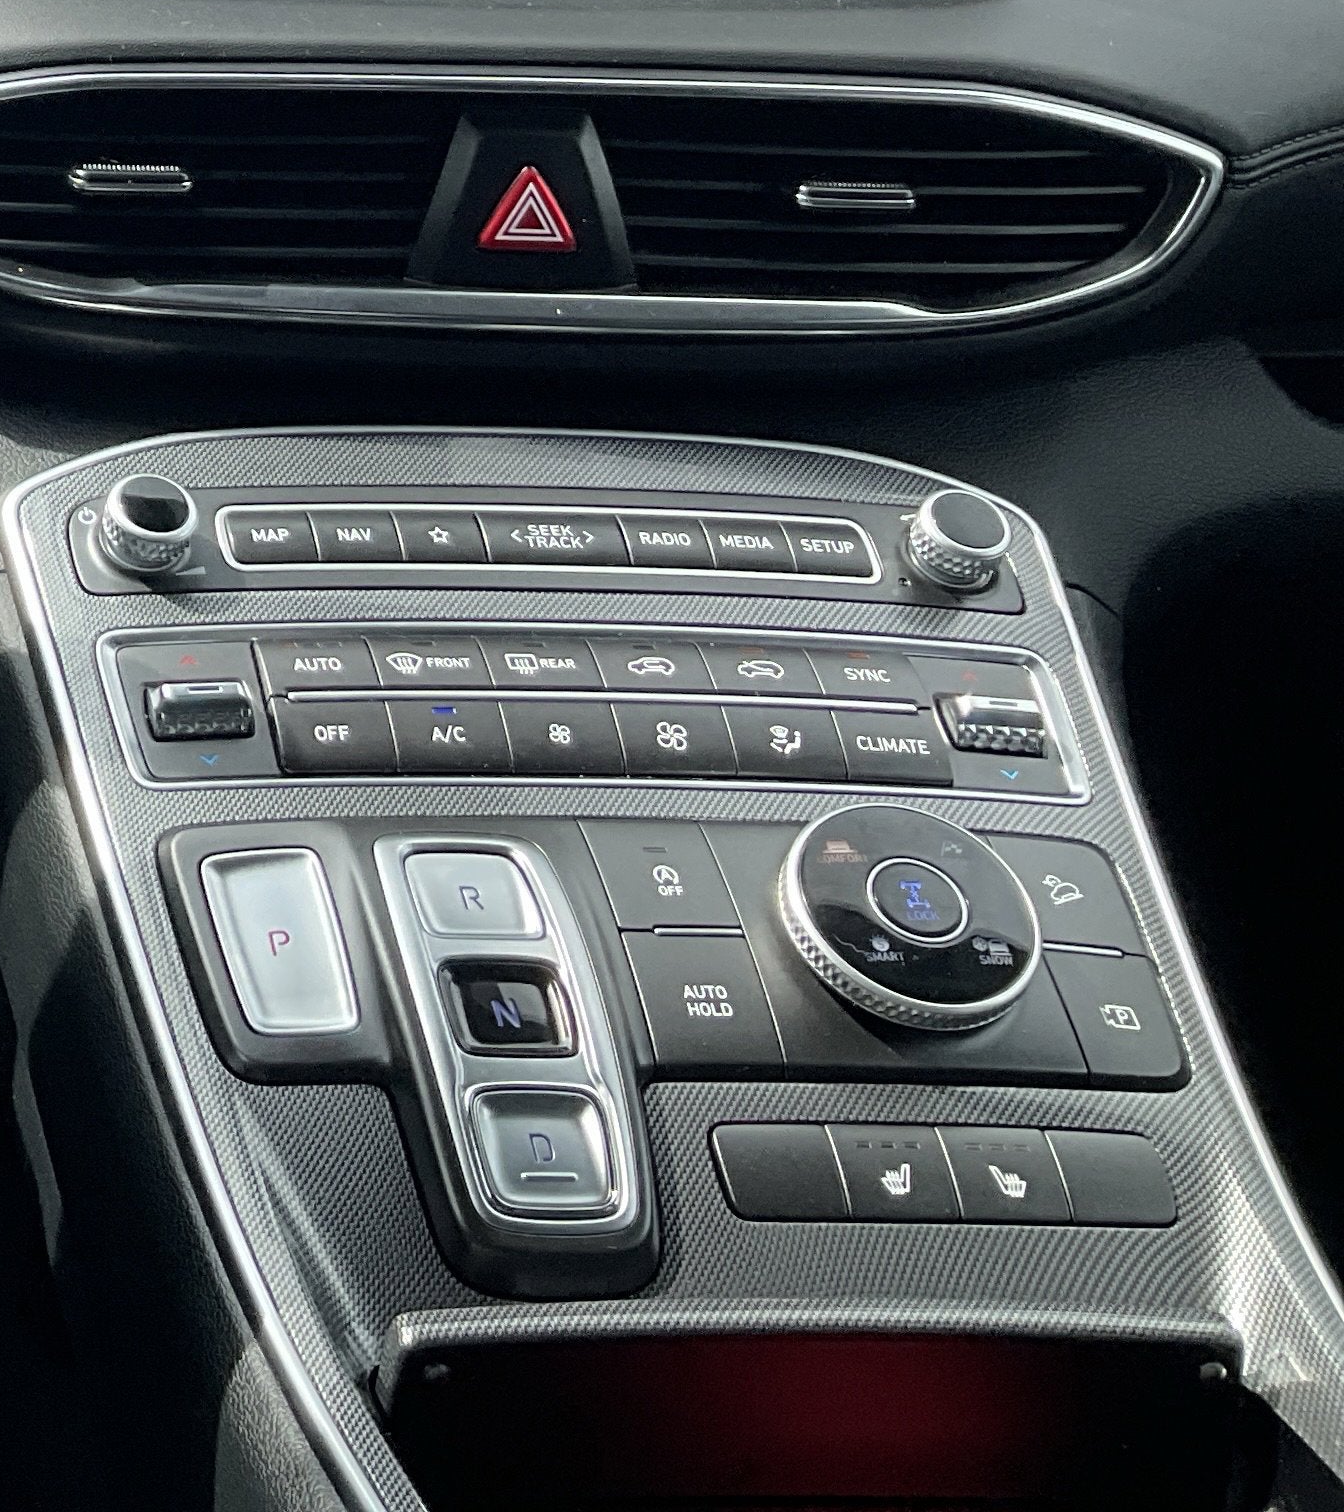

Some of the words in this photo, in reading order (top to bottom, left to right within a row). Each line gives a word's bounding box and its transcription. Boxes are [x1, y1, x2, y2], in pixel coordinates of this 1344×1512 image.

[250, 527, 290, 543] MAP
[336, 527, 373, 542] NAV
[527, 523, 575, 537] SEEK
[524, 535, 584, 549] TRACK
[638, 530, 692, 548] RADIO
[718, 533, 774, 551] MEDIA
[799, 538, 856, 555] SETUP
[292, 656, 343, 673] AUTO
[425, 656, 472, 670] FRONT
[538, 657, 578, 671] REAR
[842, 666, 892, 685] SYNC
[313, 725, 350, 742] OFF
[430, 724, 467, 743] A/C
[855, 735, 932, 756] CLIMATE
[458, 884, 486, 911] R
[656, 884, 685, 897] OFF
[906, 909, 941, 921] LOCK
[266, 929, 291, 957] P
[864, 950, 905, 963] SMART
[978, 954, 1014, 967] SNOW
[682, 984, 729, 1001] AUTO
[489, 997, 522, 1029] N
[685, 1001, 734, 1018] HOLD
[528, 1131, 557, 1163] D
